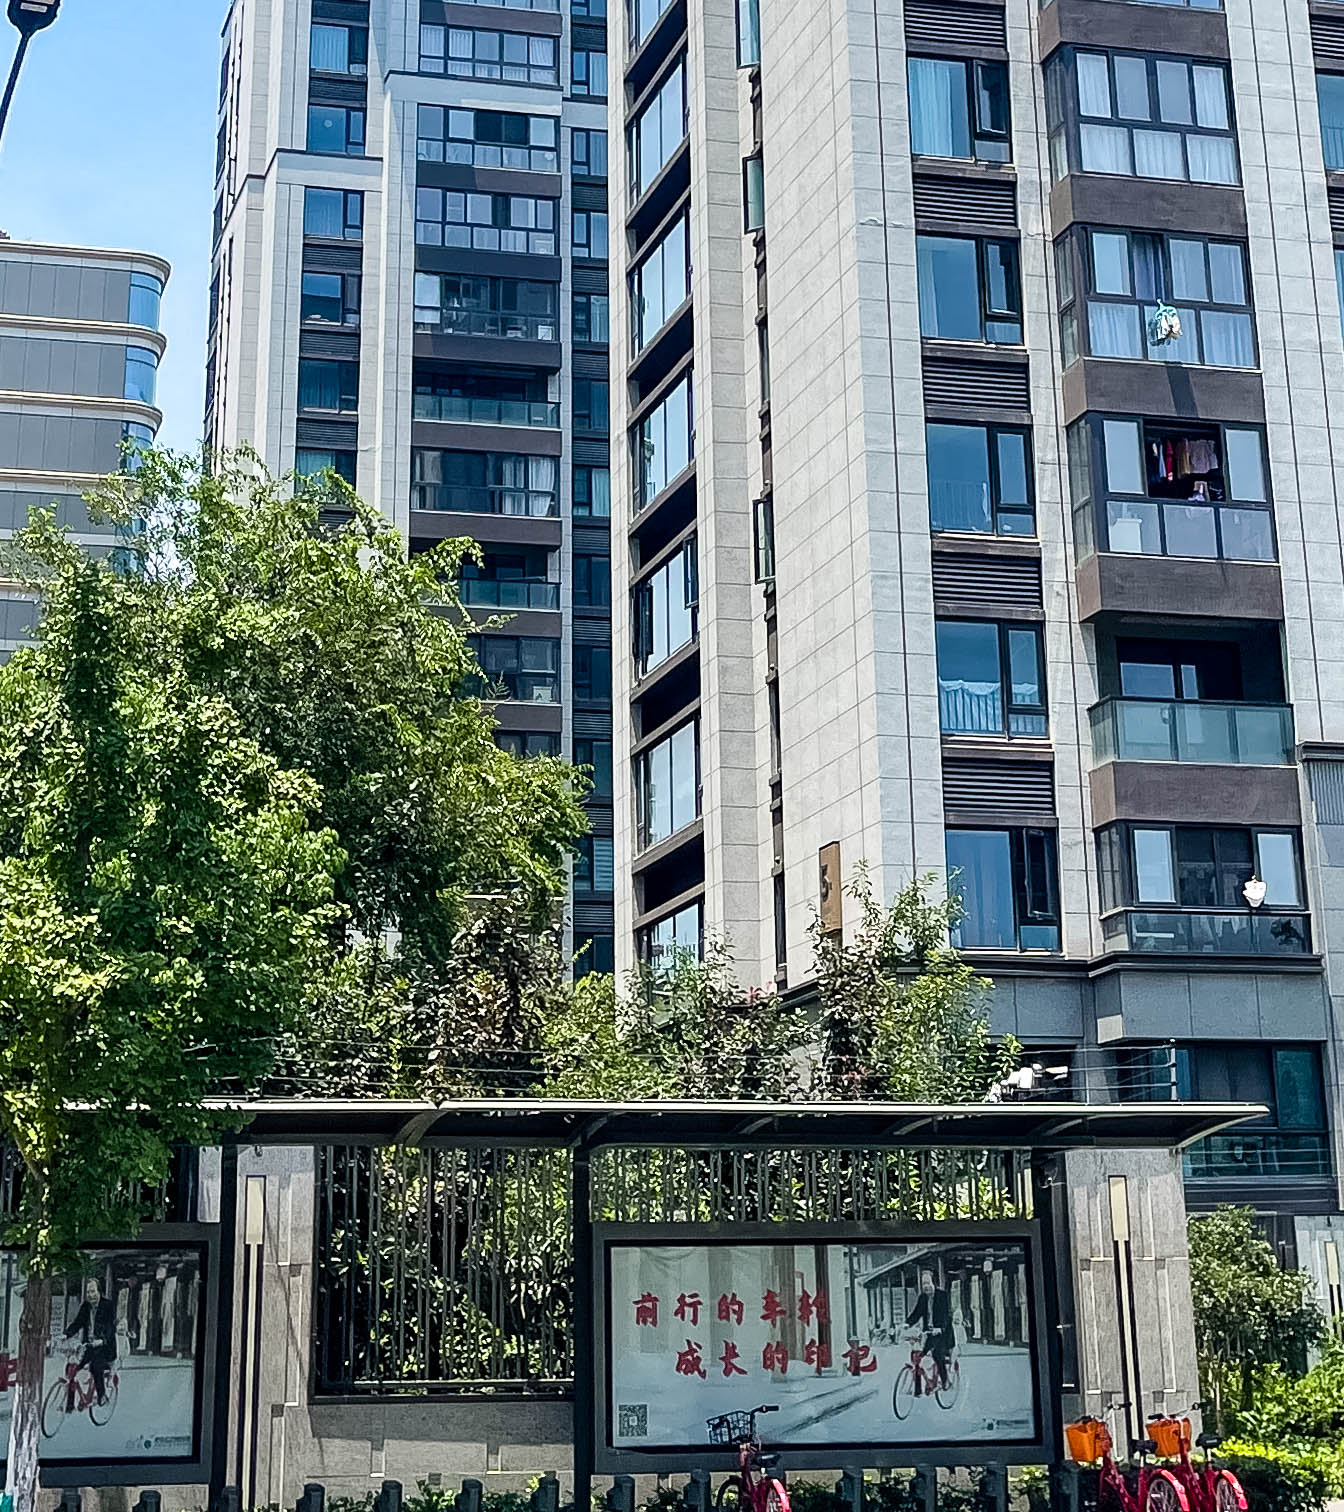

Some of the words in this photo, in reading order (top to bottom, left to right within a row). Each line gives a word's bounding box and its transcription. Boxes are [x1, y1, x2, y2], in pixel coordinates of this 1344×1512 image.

[632, 1288, 832, 1328] 前行的车轮
[675, 1338, 878, 1380] 成长的印记
